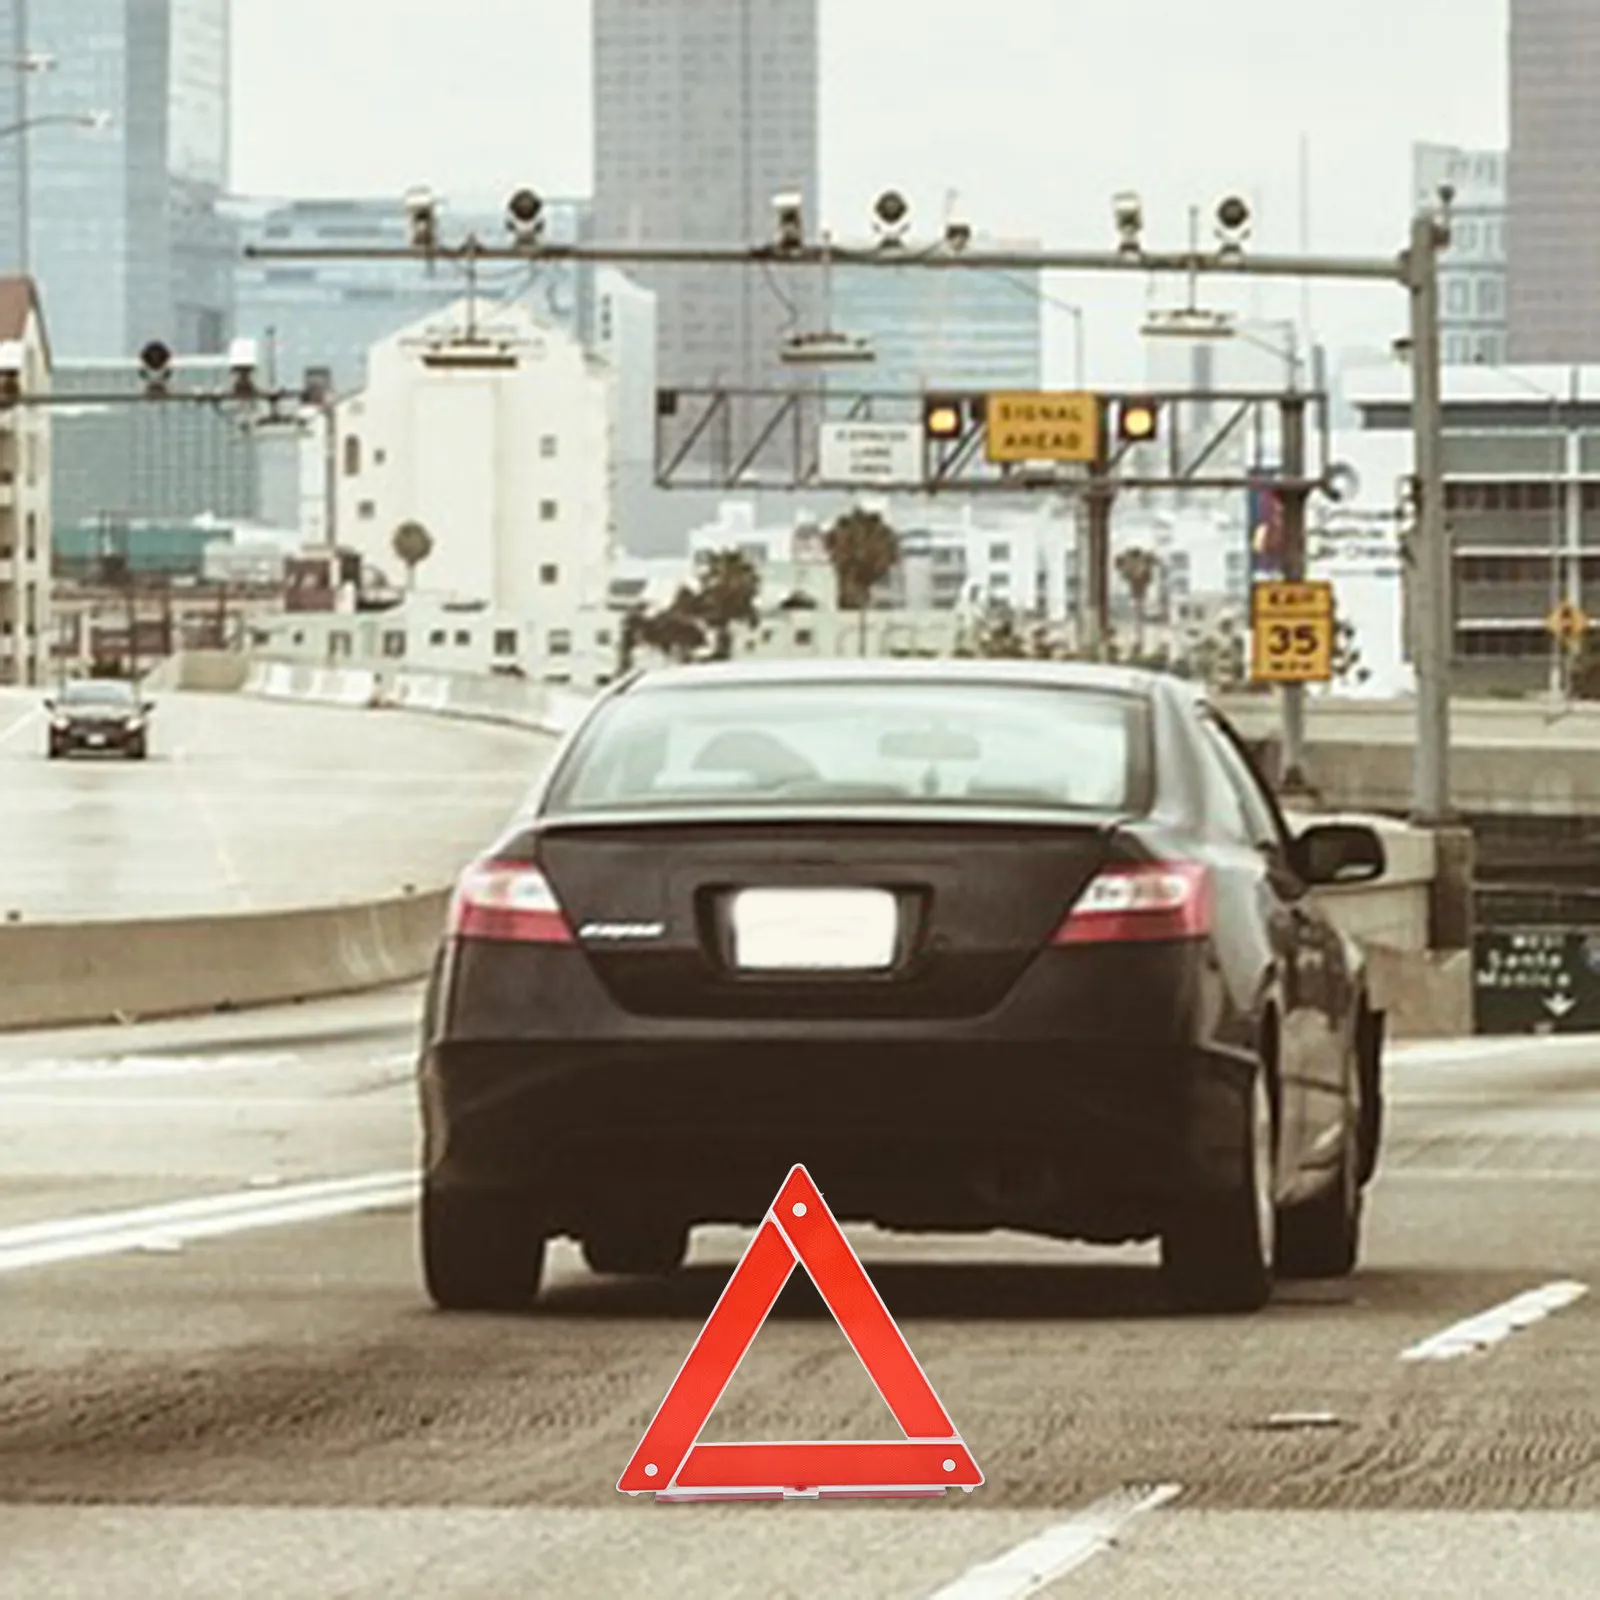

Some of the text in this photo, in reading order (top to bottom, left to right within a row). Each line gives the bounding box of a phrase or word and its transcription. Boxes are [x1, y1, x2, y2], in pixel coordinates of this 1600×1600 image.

[1001, 403, 1082, 421] SIGNAL
[1002, 431, 1082, 451] AHEAD
[1268, 624, 1319, 656] 35
